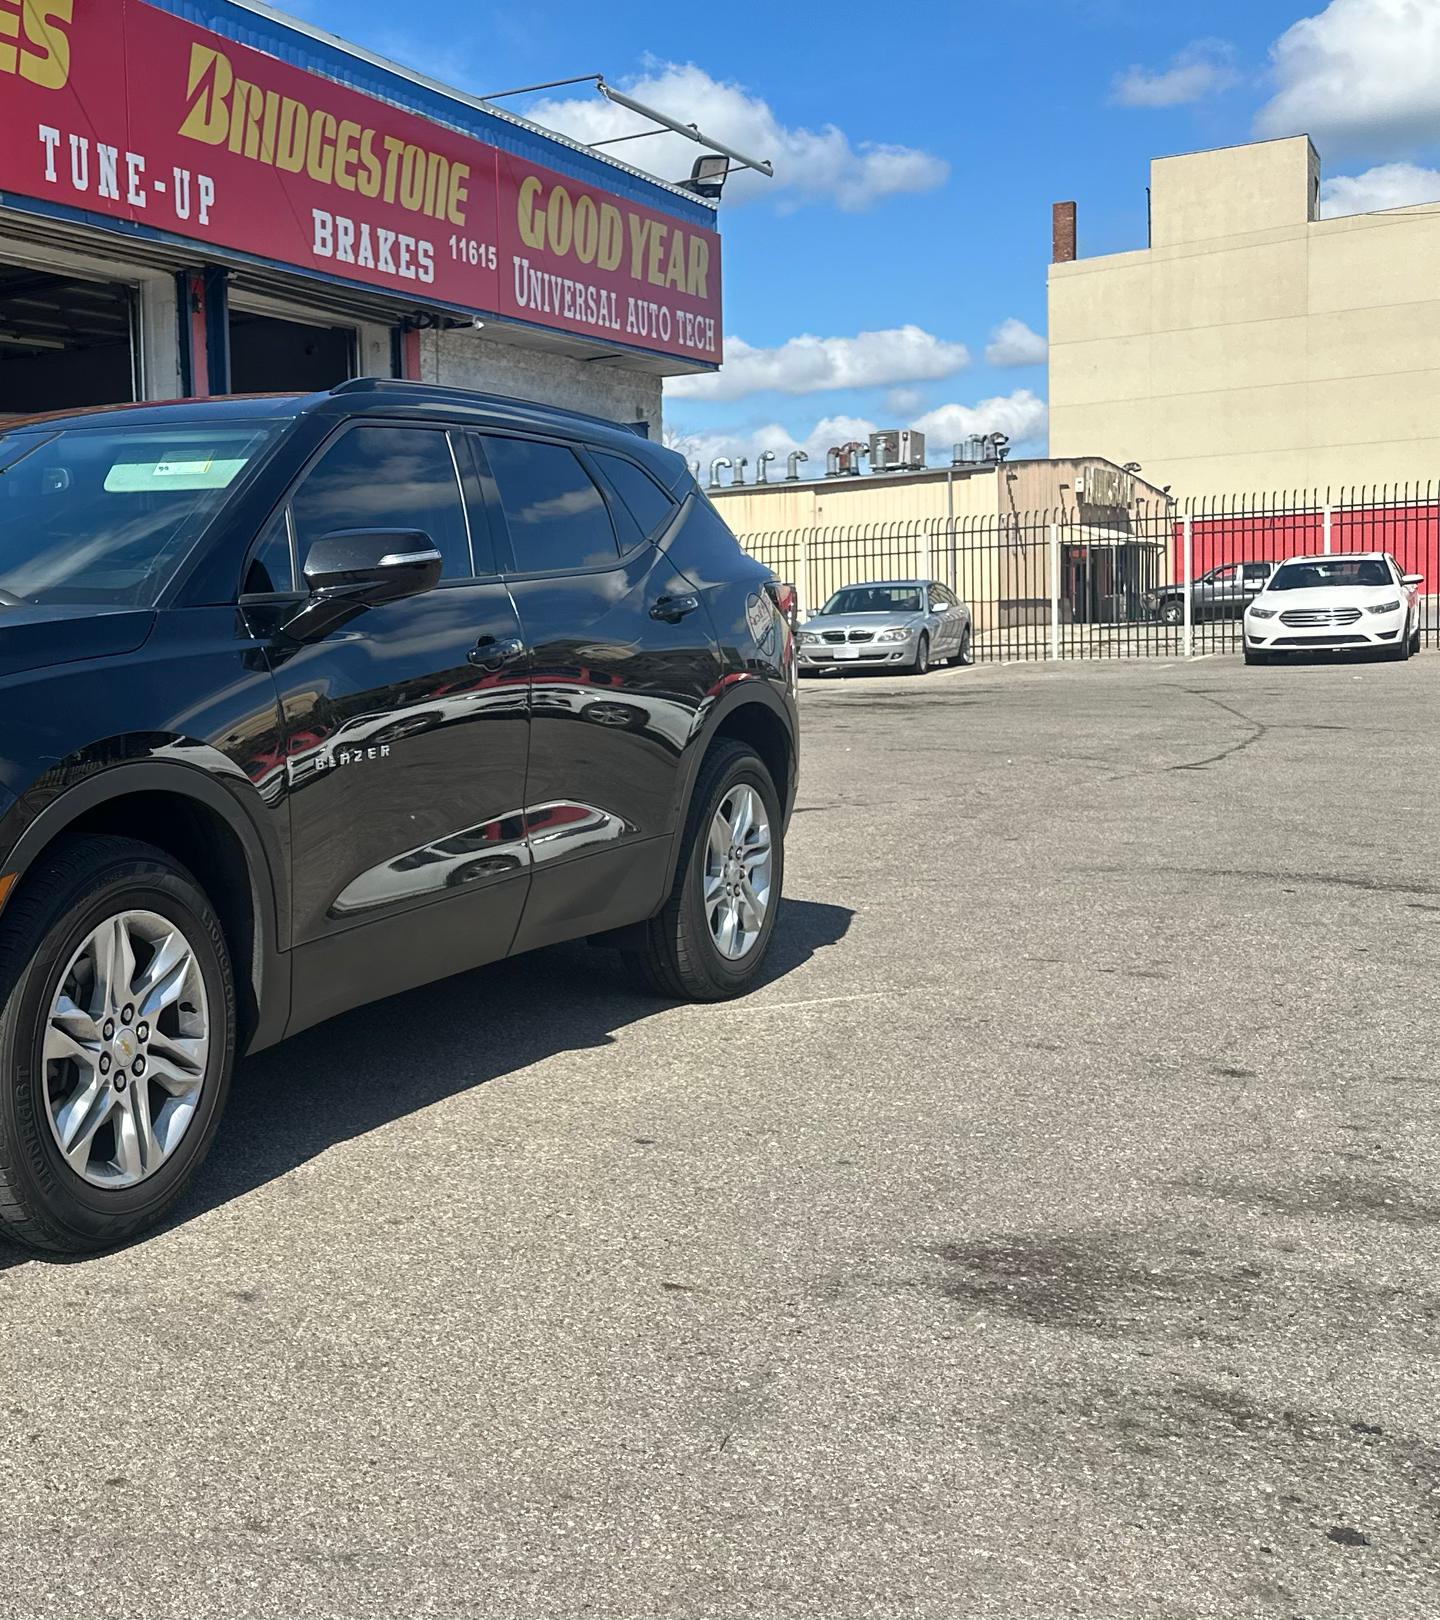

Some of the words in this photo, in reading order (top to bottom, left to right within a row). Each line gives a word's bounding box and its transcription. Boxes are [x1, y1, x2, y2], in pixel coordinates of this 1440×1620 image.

[38, 123, 215, 226] TUNE-UP
[177, 41, 470, 227] BRIDGESTONE
[311, 208, 435, 283] BRAKES
[448, 234, 497, 270] 11615
[513, 256, 620, 330] UNIVERSAL
[626, 297, 671, 342] AUTO
[676, 310, 715, 351] TECH
[314, 744, 390, 771] BLAZER
